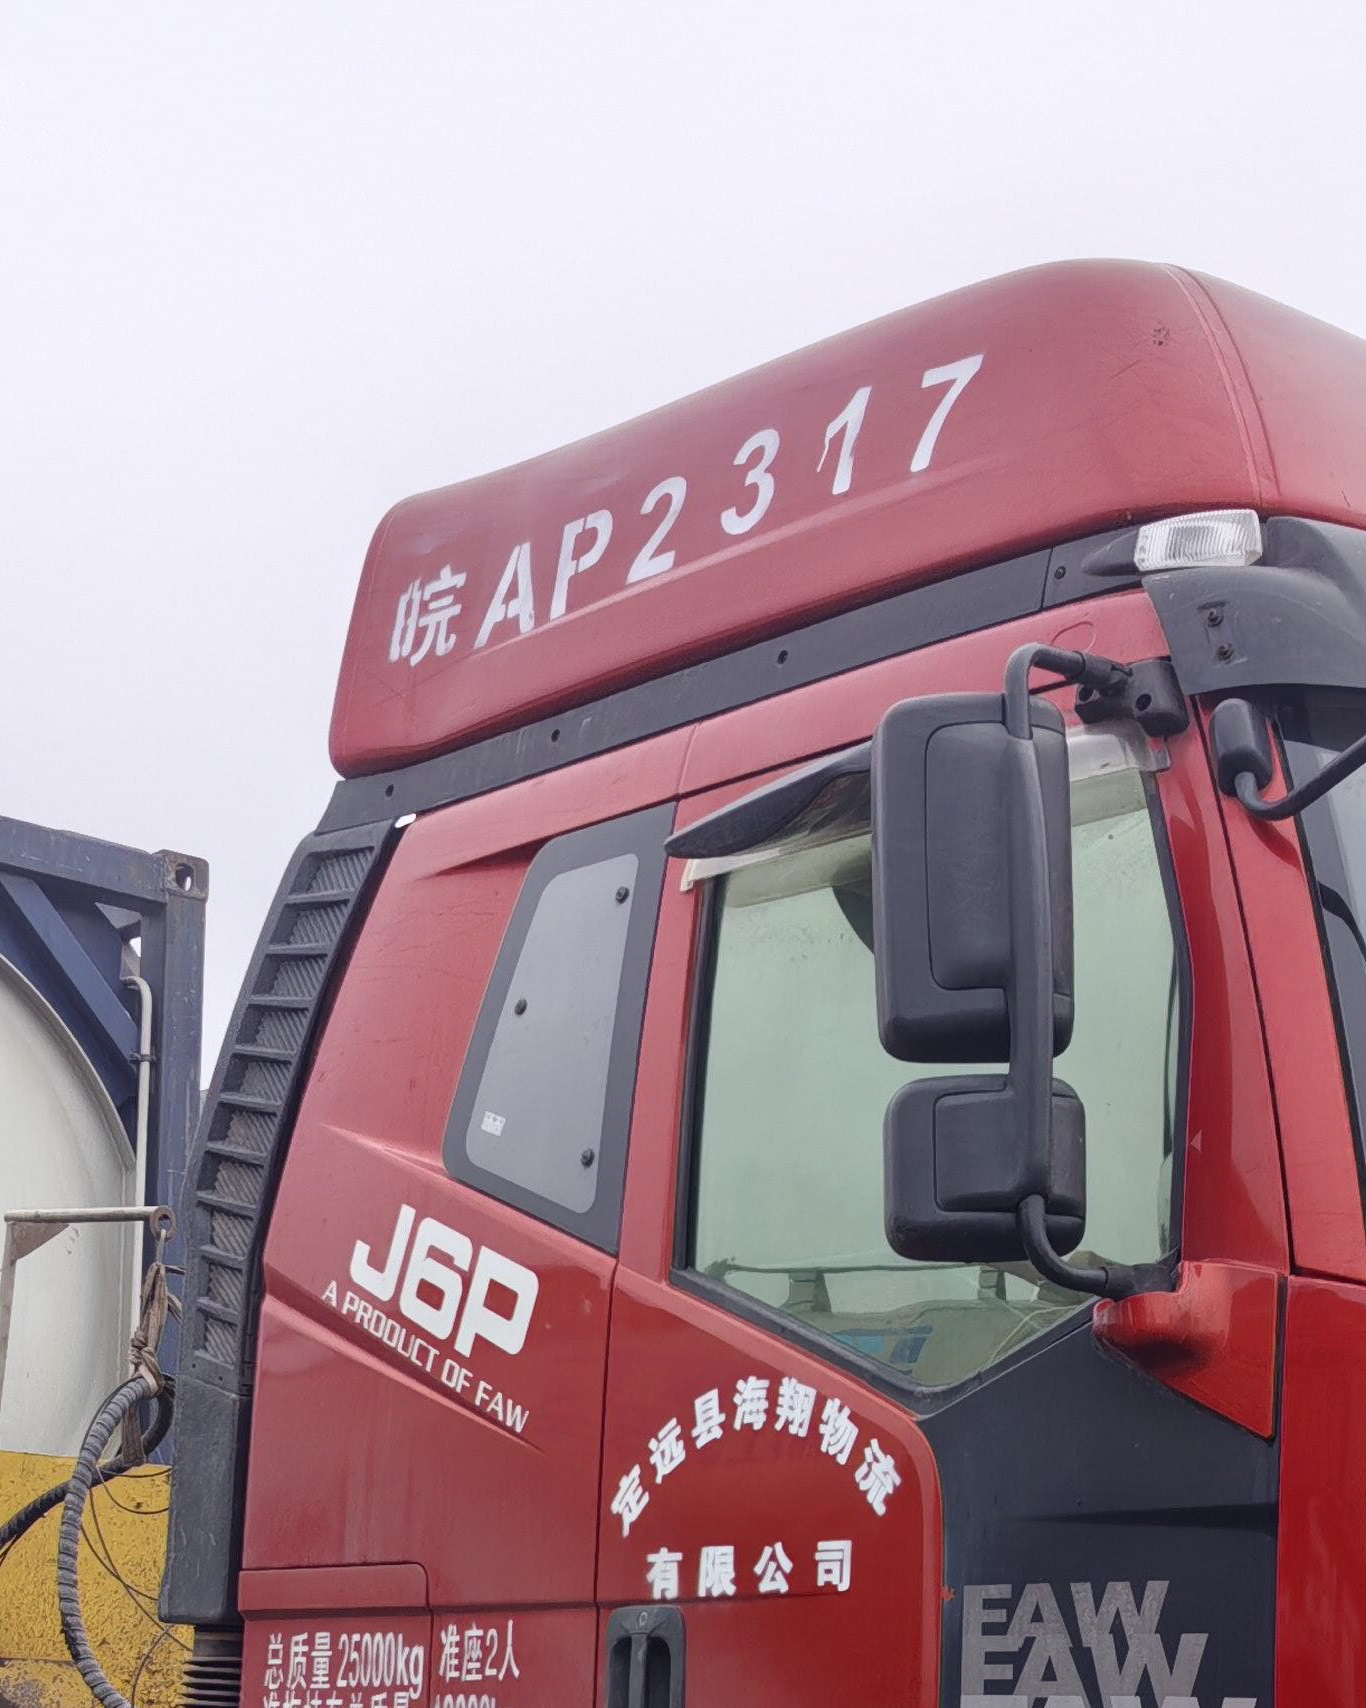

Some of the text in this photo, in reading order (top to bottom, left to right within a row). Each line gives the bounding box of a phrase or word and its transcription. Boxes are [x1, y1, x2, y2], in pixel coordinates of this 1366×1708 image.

[388, 353, 984, 667] 皖AP2317
[321, 1280, 530, 1433] A PRODUCT OF FAW
[350, 1203, 539, 1358] J6P
[610, 1376, 902, 1538] 定远县海翔物流
[646, 1540, 853, 1600] 有限公司
[439, 1619, 520, 1682] 准座2人
